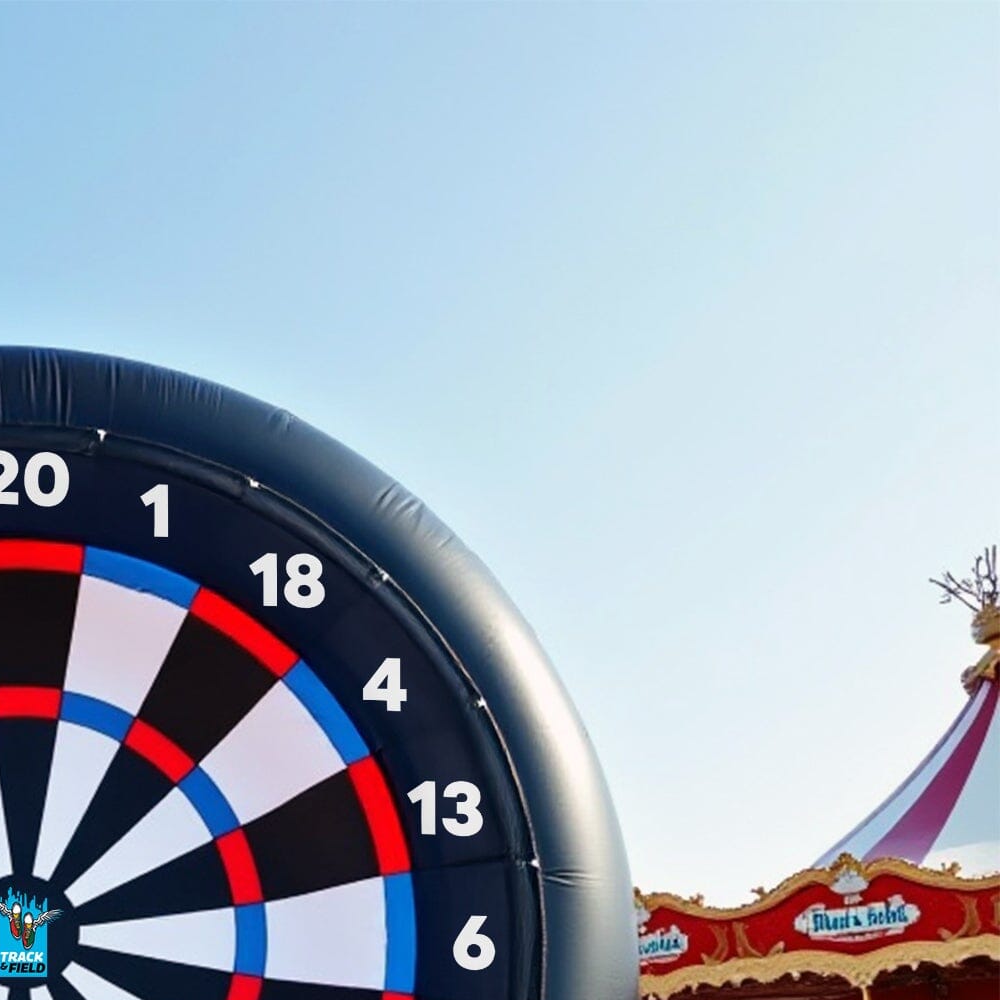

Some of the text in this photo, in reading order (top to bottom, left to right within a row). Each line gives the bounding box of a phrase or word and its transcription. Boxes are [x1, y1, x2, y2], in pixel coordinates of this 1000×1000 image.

[141, 484, 168, 537] 1
[250, 553, 325, 608] 18
[363, 658, 407, 711] 4
[407, 781, 483, 836] 13
[0, 951, 43, 962] TRACK
[9, 963, 45, 973] FIELD
[453, 916, 495, 970] 6
